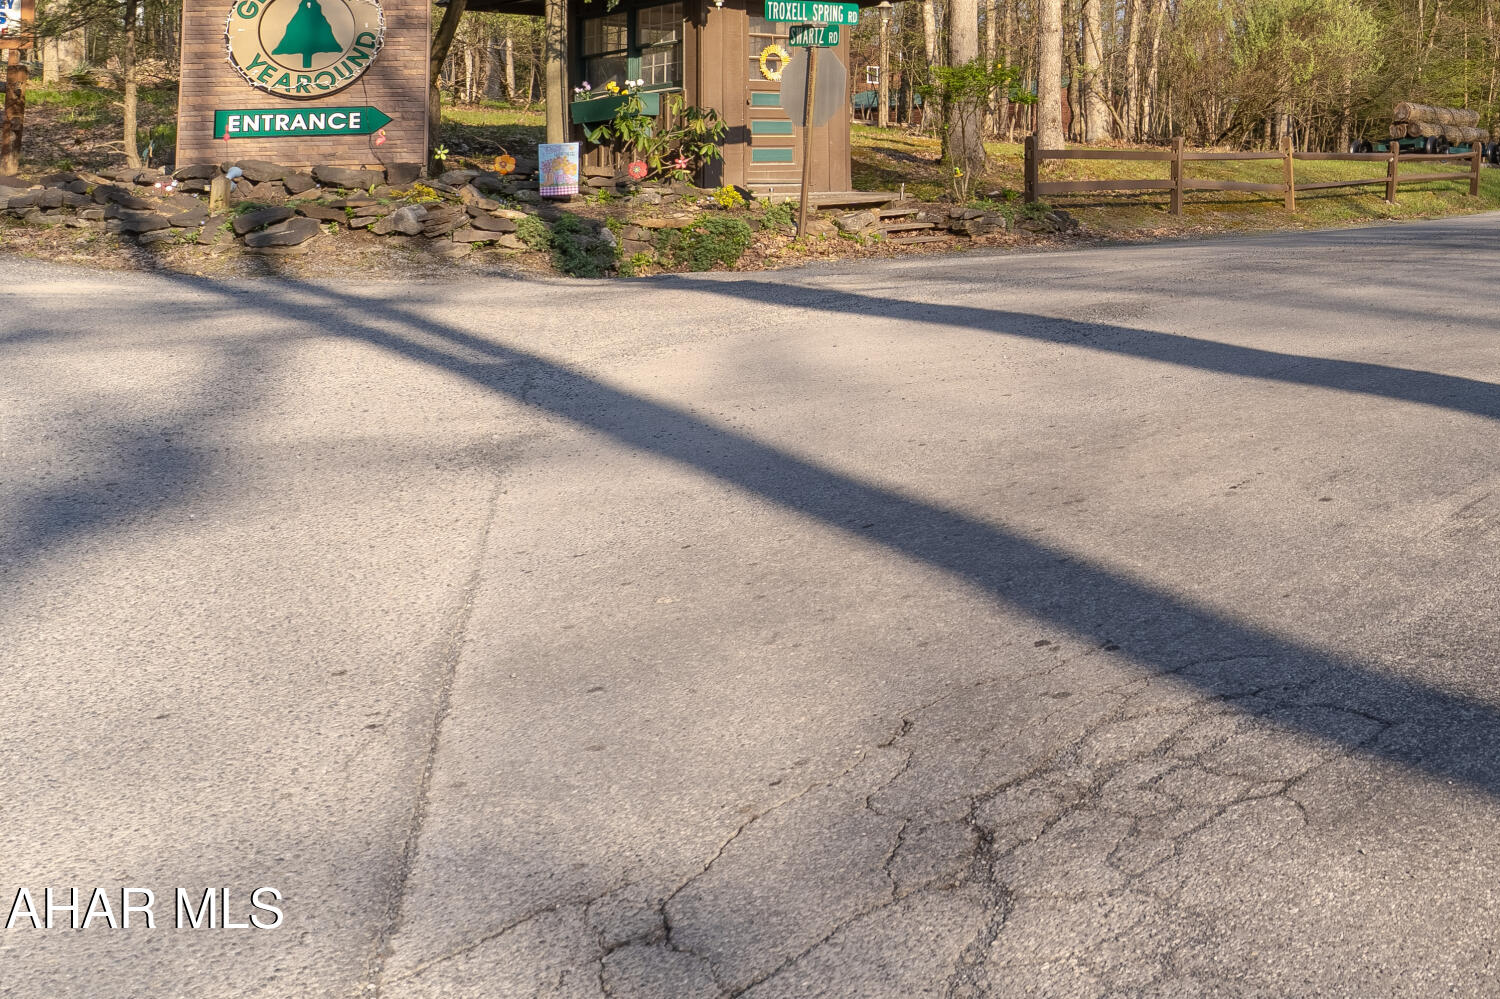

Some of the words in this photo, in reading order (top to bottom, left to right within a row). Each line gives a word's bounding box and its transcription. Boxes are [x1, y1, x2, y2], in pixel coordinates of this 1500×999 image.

[768, 2, 807, 21] TROXELL
[812, 4, 843, 22] SPRING
[848, 11, 858, 23] RD
[790, 27, 824, 44] SWARTZ
[828, 31, 838, 44] RD
[246, 32, 376, 93] YEAROUND
[228, 112, 361, 132] ENTRANCE
